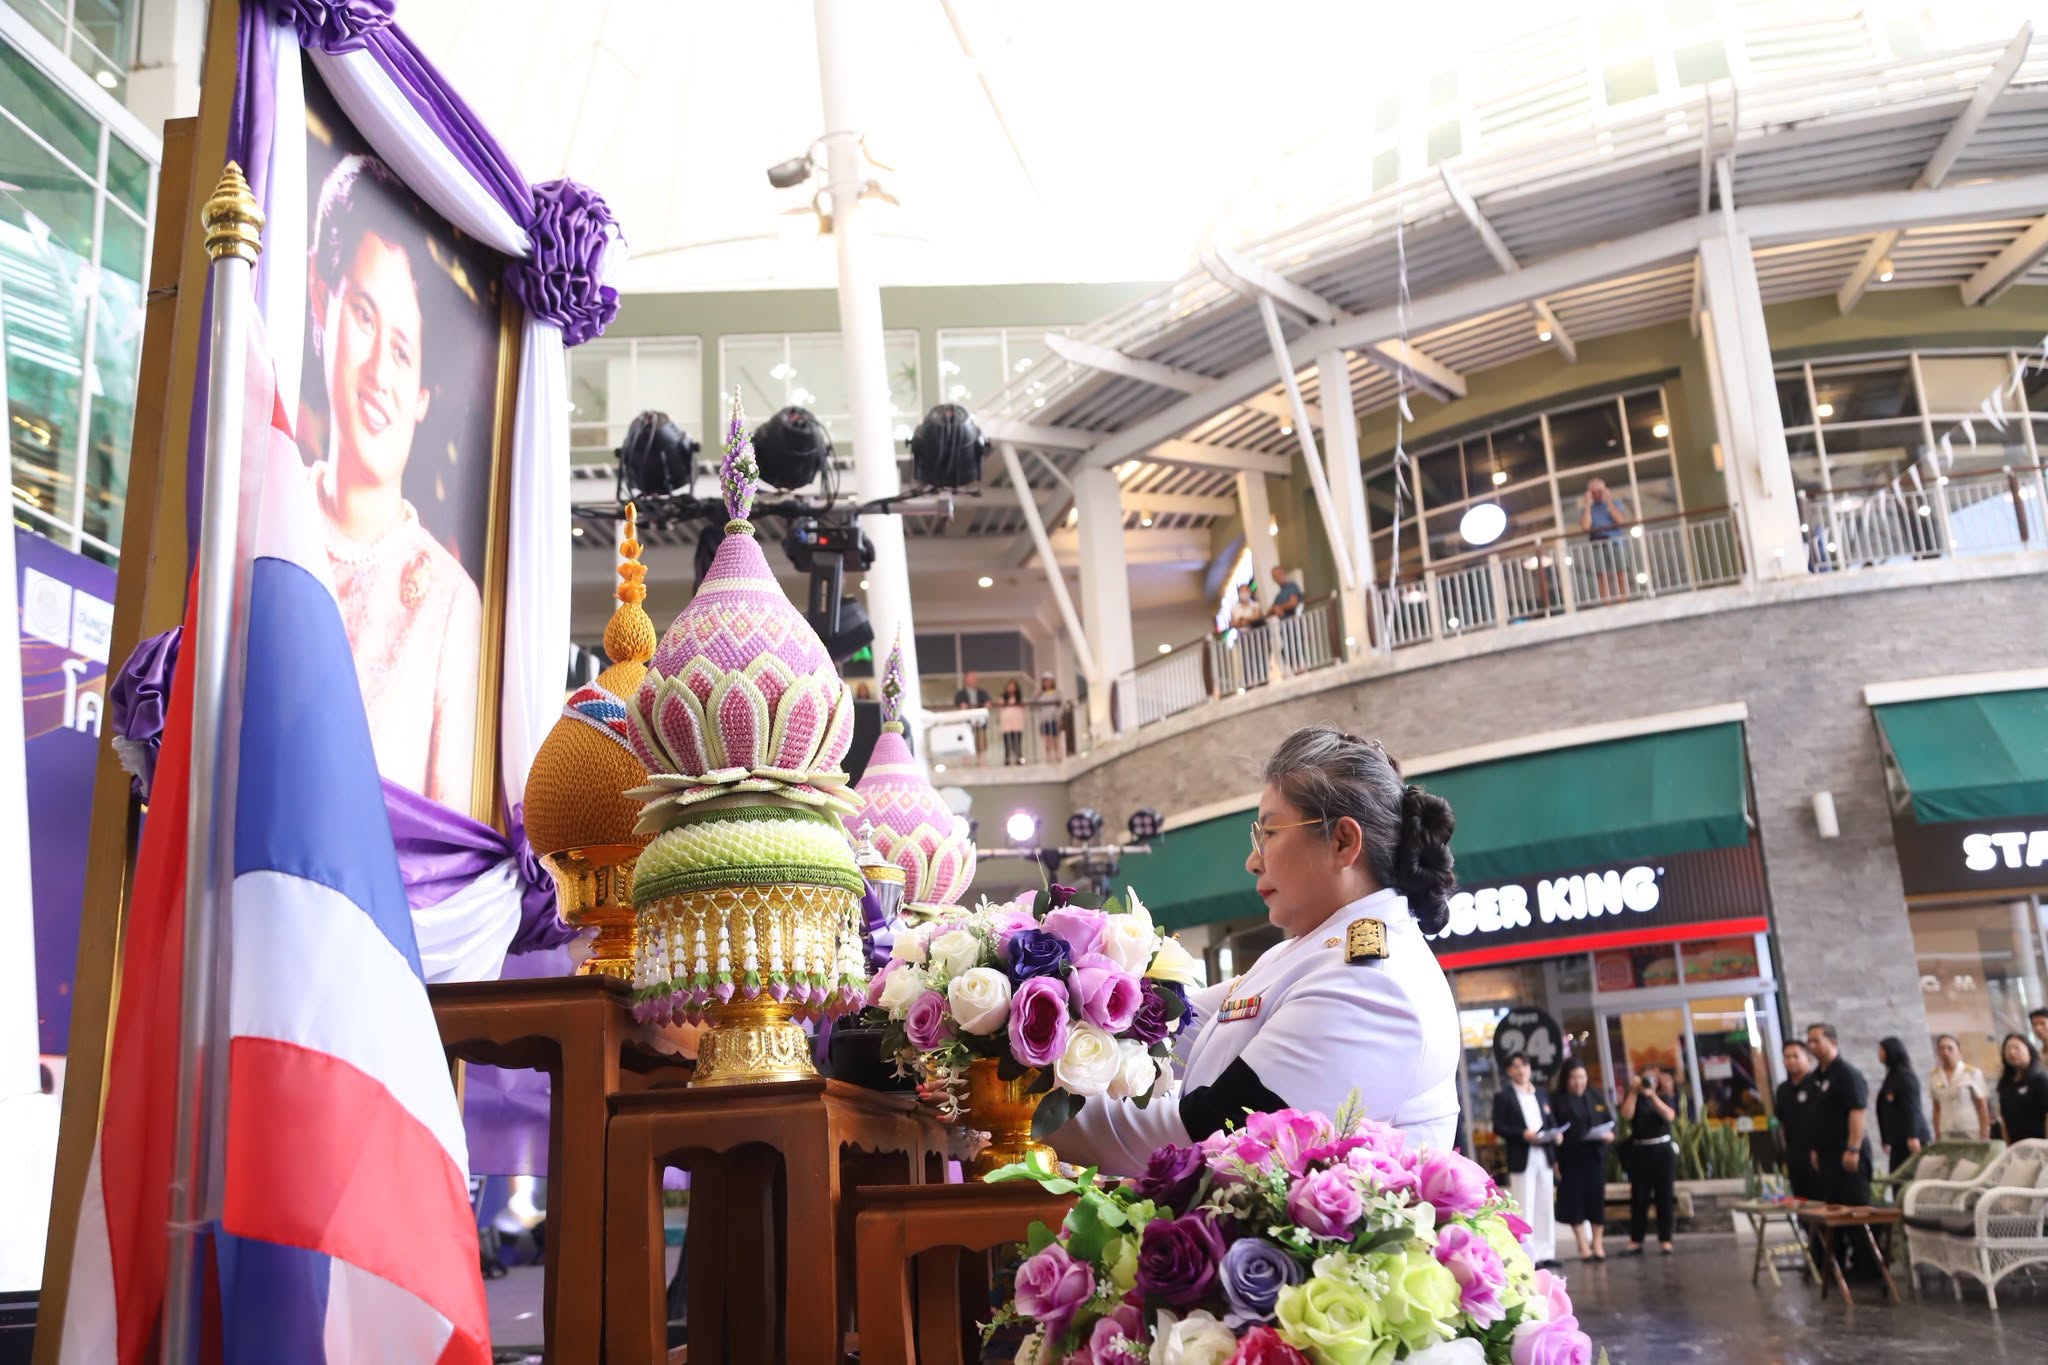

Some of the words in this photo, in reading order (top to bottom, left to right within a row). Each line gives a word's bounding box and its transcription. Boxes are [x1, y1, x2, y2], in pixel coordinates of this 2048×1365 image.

[1424, 884, 1532, 941] GER
[1537, 866, 1660, 924] KING
[1500, 1026, 1557, 1065] 24
